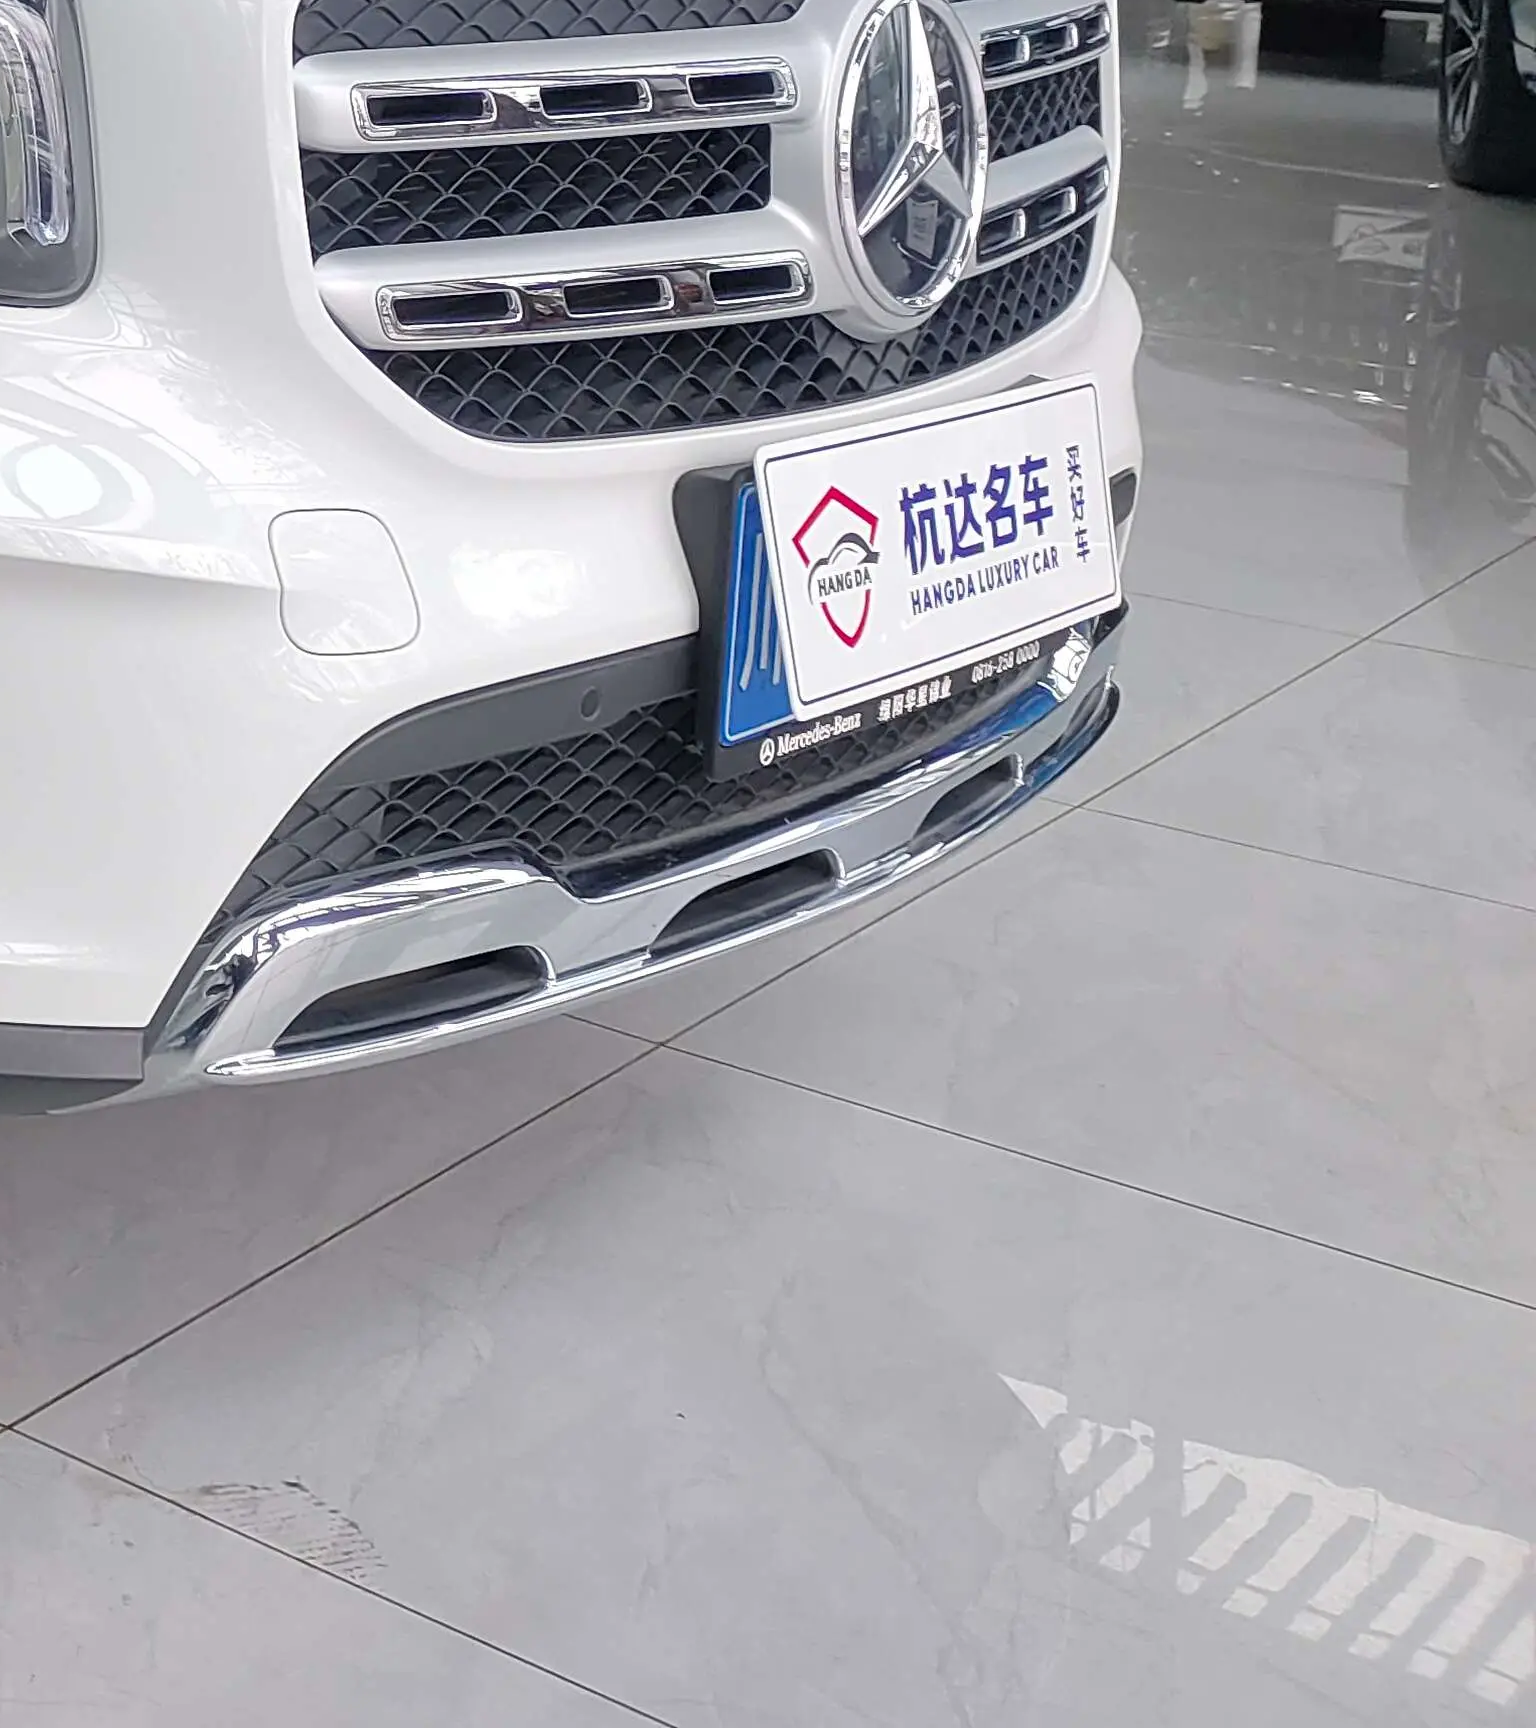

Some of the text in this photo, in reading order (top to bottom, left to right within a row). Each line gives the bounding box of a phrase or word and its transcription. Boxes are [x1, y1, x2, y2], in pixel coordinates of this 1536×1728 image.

[899, 454, 1054, 576] 杭达名车
[817, 566, 873, 597] HANG DA
[910, 545, 1060, 616] HANGDA LUXURY CAR
[776, 711, 863, 757] Mercedes-Benz
